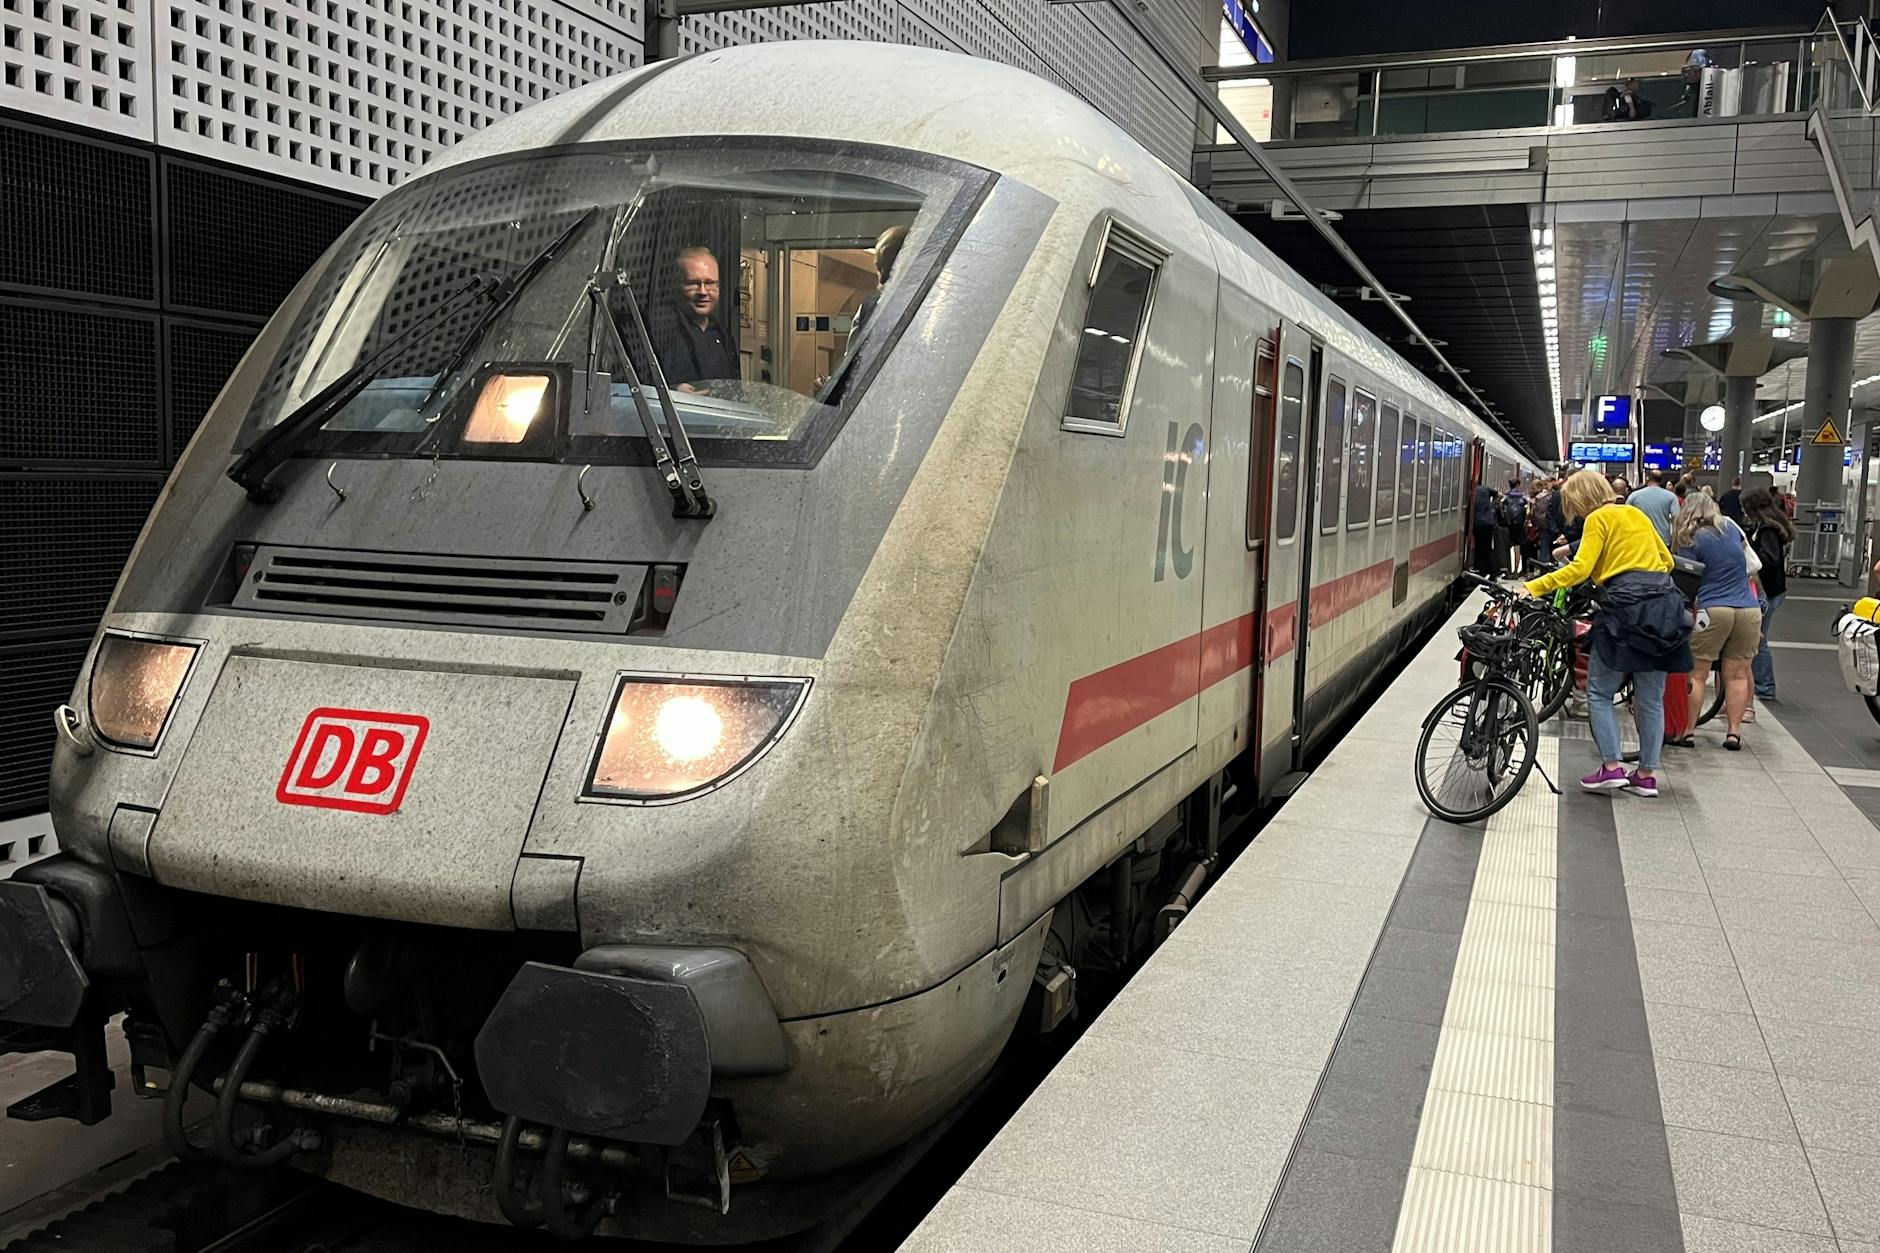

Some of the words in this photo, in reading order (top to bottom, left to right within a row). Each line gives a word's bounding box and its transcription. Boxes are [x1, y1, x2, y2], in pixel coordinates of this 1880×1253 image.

[1597, 396, 1617, 422] F
[1778, 460, 1788, 472] E
[295, 724, 405, 795] DB
